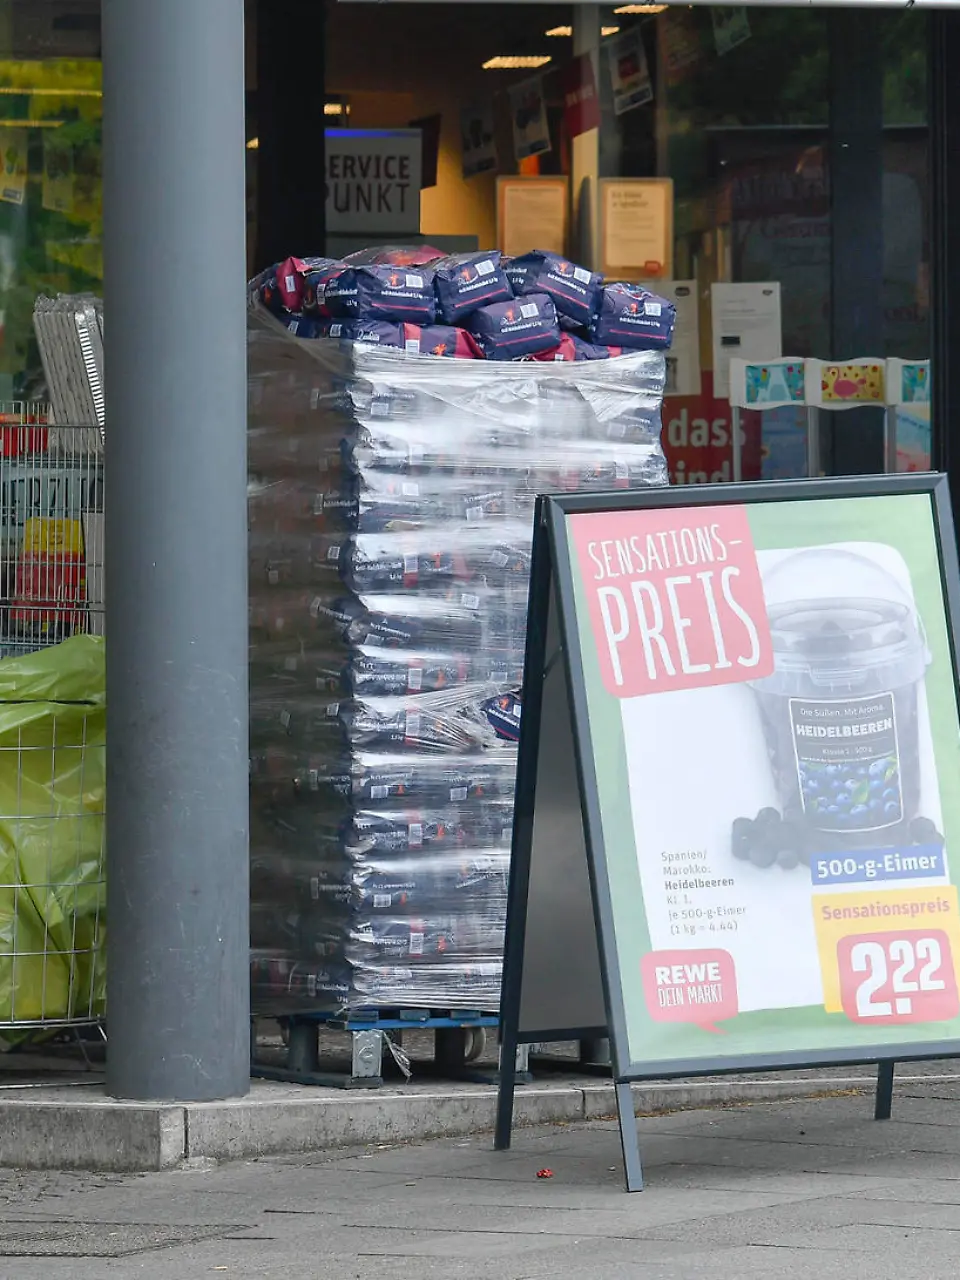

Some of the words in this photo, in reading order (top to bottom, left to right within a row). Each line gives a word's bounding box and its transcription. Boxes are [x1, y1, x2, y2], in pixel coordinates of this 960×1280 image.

[328, 154, 411, 180] ERVICE
[587, 523, 743, 581] SENSATIONS-
[596, 565, 761, 686] PREIS
[795, 717, 893, 738] HEIDELBEEREN
[817, 853, 938, 879] 500-g-Eimer
[665, 877, 735, 891] Heidelbeeren
[821, 895, 951, 921] Sensationspreis
[655, 961, 722, 986] REWE
[657, 986, 685, 1008] DEIN
[687, 982, 724, 1005] MARKT
